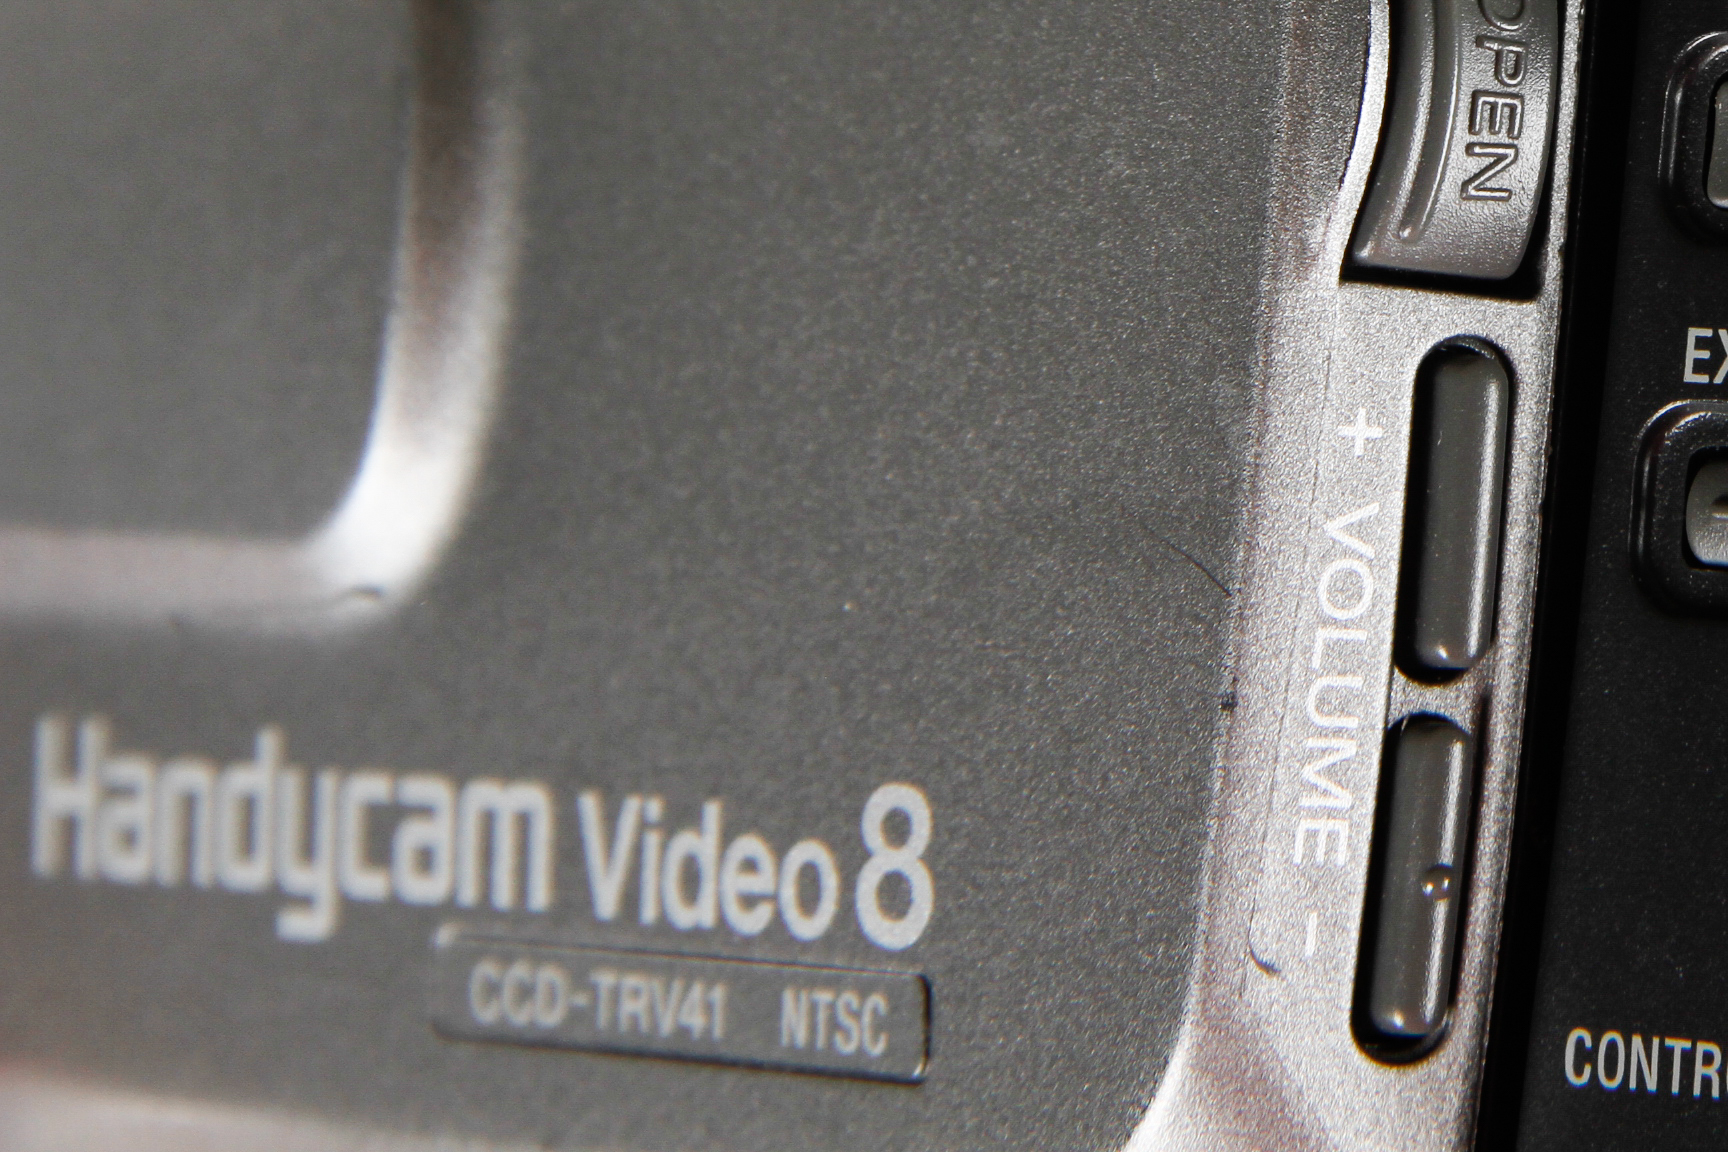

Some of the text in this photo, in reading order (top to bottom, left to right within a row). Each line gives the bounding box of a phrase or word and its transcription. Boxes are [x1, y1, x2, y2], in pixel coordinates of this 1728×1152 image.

[1293, 502, 1380, 866] VOLUME
[32, 714, 555, 942] Handycam
[469, 958, 890, 1057] CCD-TRV41 NTSC
